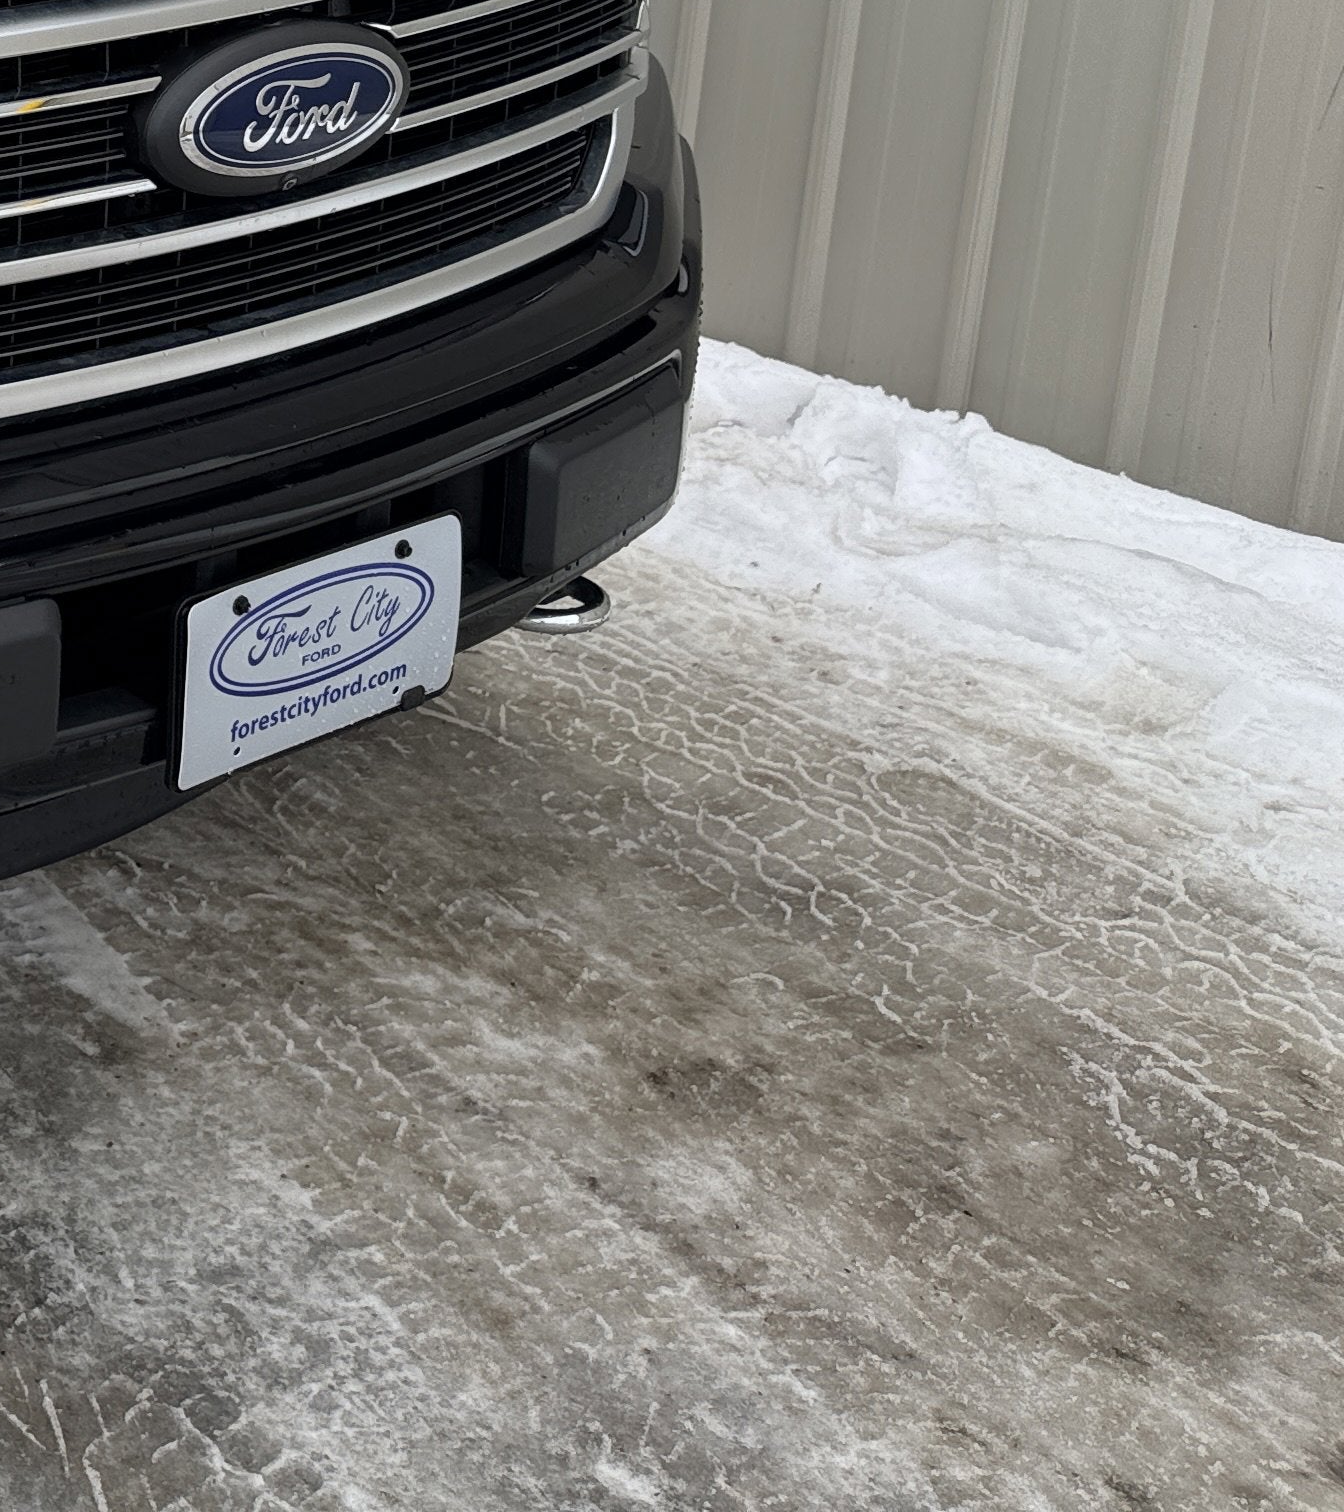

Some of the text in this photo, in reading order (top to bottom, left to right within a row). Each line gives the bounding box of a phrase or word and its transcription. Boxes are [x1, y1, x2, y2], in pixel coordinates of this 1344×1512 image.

[243, 72, 361, 152] Ford
[247, 584, 401, 667] Forest City
[301, 643, 342, 667] FORD
[229, 663, 408, 744] forestcityford.com
